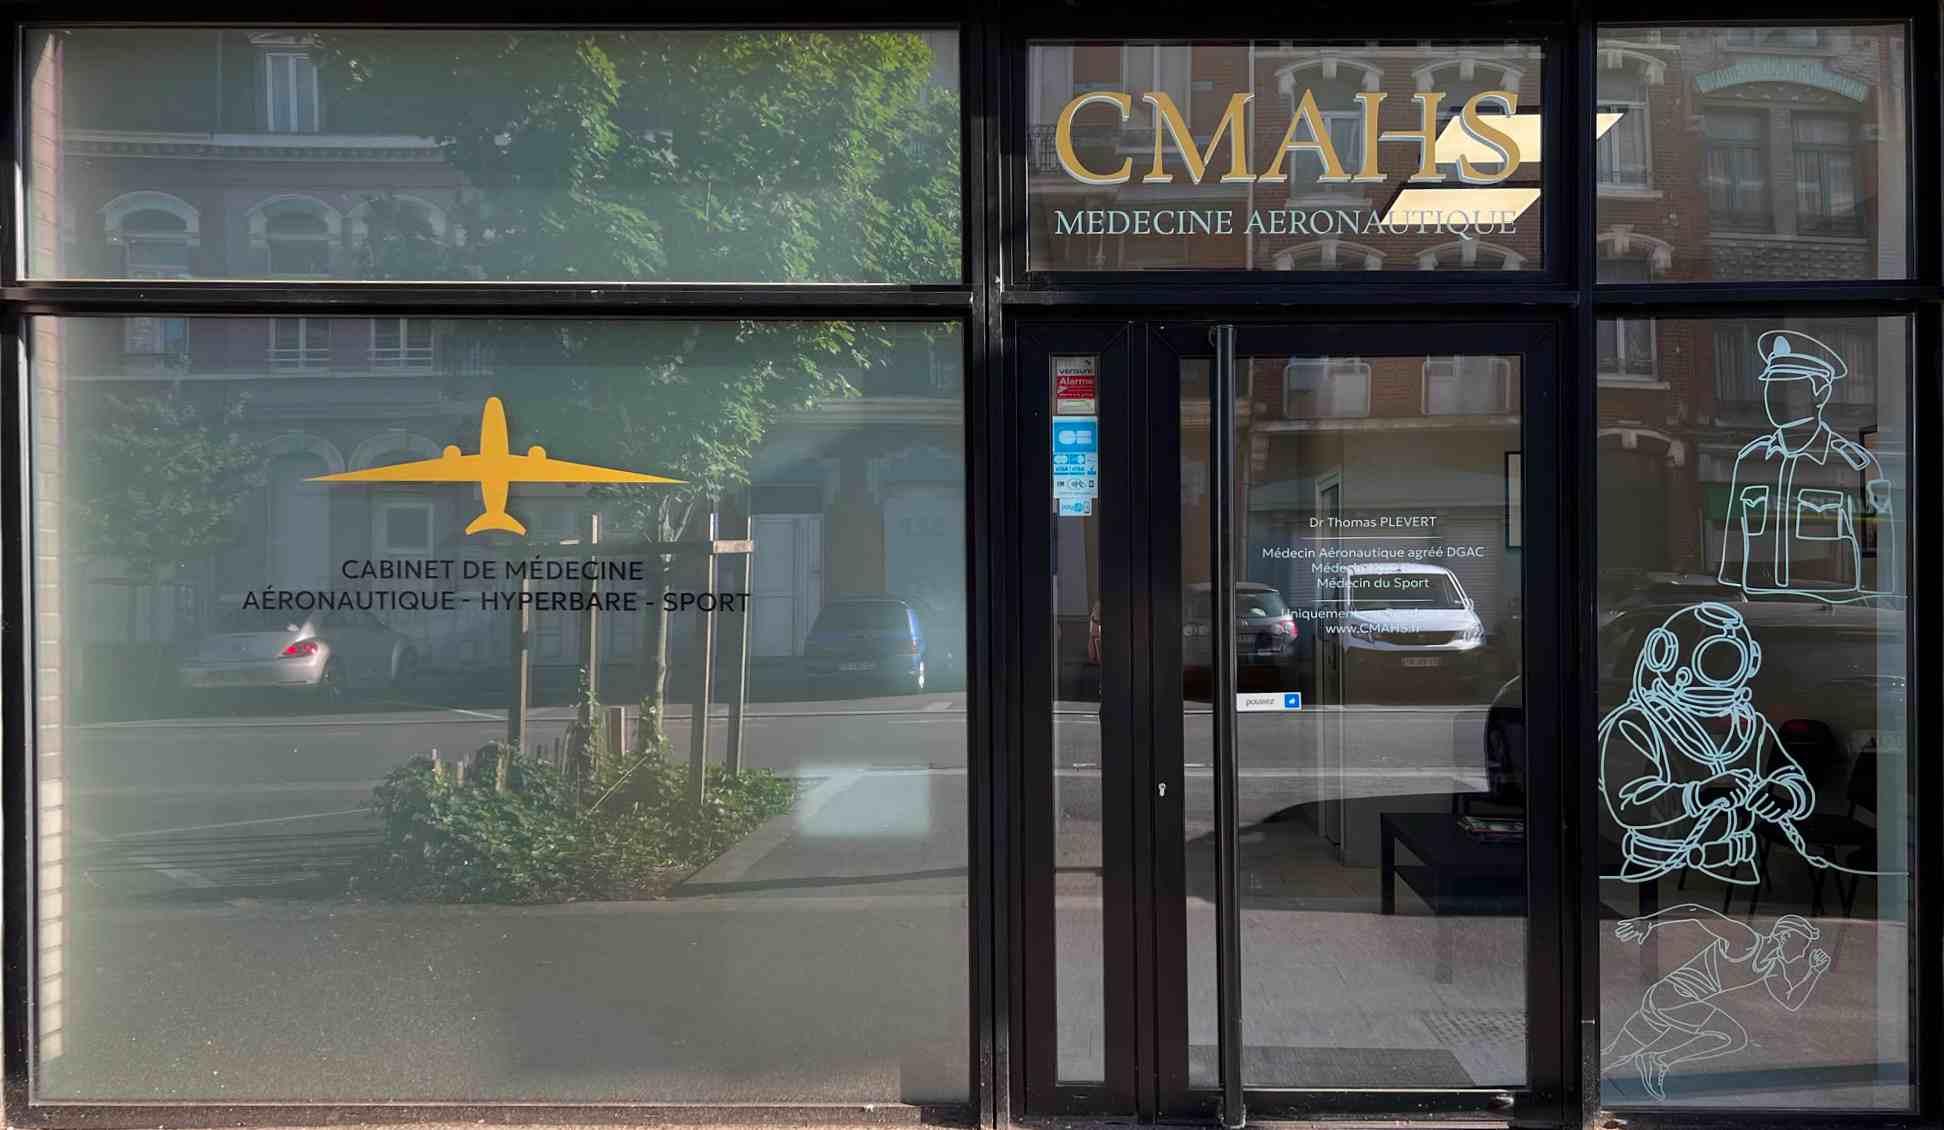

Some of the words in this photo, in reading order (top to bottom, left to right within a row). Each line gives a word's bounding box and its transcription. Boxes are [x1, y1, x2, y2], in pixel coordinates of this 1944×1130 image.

[1055, 88, 1521, 185] CMAHS
[1055, 209, 1233, 235] MEDECINE
[1246, 209, 1517, 240] AERONAUTIQUE
[1309, 517, 1324, 528] Dr
[1327, 516, 1377, 528] Thomas
[1380, 516, 1437, 527] PLEVERT
[1262, 547, 1315, 559] Médecin
[1318, 547, 1404, 561] Aéronautique
[1407, 546, 1443, 560] agréé
[1447, 546, 1485, 557] DGAC
[341, 559, 455, 581] CABINET
[463, 559, 496, 580] DE
[505, 555, 644, 581] MÉDECINE
[1374, 578, 1390, 589] du
[1394, 578, 1430, 590] Sport
[241, 584, 456, 611] AÉRONAUTIQUE
[481, 591, 637, 612] HYPERBARE
[663, 591, 751, 612] SPORT
